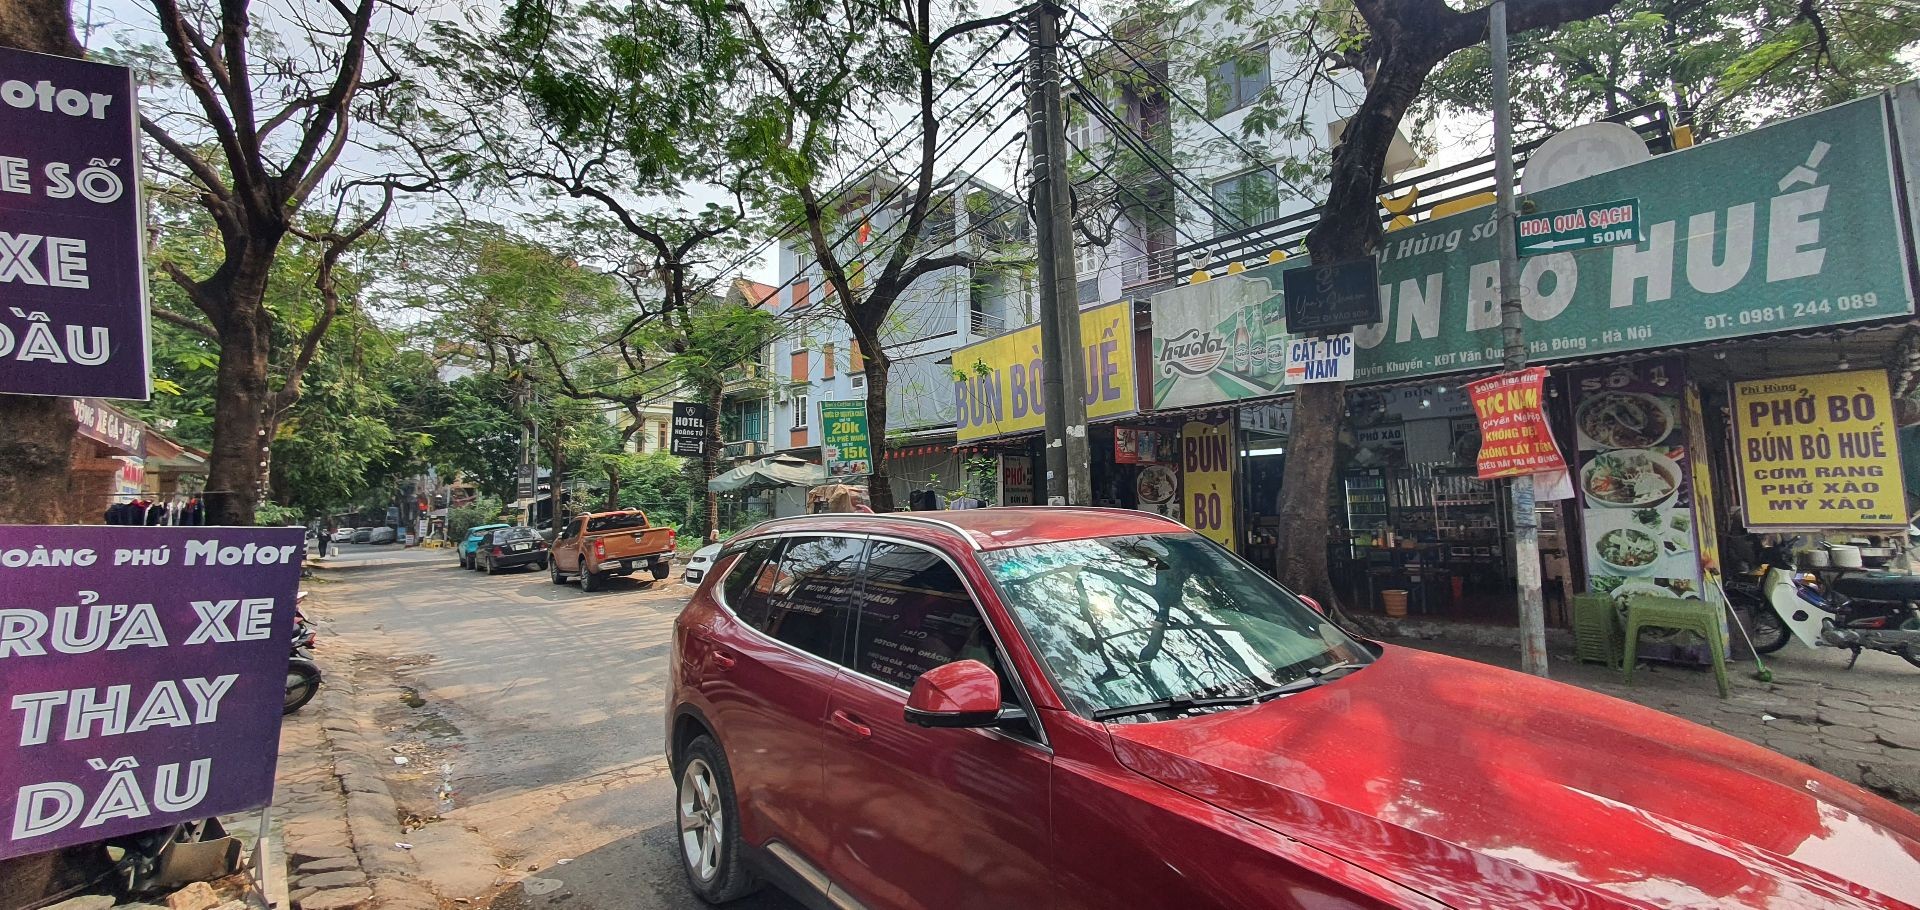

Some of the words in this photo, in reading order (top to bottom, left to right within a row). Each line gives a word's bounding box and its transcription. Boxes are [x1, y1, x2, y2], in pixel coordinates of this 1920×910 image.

[0, 80, 113, 120] otor
[0, 156, 32, 195] E
[45, 157, 124, 204] SỐ
[1520, 218, 1551, 237] HOA
[1554, 208, 1586, 233] QUẢ
[1589, 205, 1632, 229] SẠCH
[1592, 228, 1632, 243] 50M
[1610, 140, 1831, 308] HUẾ
[0, 231, 90, 290] XE
[1396, 228, 1463, 260] Hùng
[1704, 314, 1733, 330] ĐT:
[1739, 307, 1785, 326] 0981
[1793, 300, 1832, 319] 244
[1838, 292, 1877, 312] 089
[1160, 328, 1227, 362] huda
[1325, 333, 1351, 358] TÓC
[1355, 361, 1383, 378] guyễn
[1435, 352, 1456, 367] KĐT
[1459, 349, 1482, 363] Văn
[1530, 341, 1548, 353] Hà
[1552, 337, 1587, 351] Đông
[1602, 330, 1622, 344] Hà
[1627, 325, 1652, 342] Nội
[1082, 318, 1121, 407] UẾ
[1304, 358, 1338, 380] NAM
[1507, 388, 1538, 411] NAM
[1741, 385, 1760, 396] Phi
[1763, 383, 1797, 394] Hùng
[675, 416, 704, 428] HOTEL
[1749, 388, 1816, 427] PHỞ
[1827, 386, 1876, 422] BÒ
[832, 422, 859, 435] 20k
[1485, 427, 1519, 442] KHÔNG
[1747, 431, 1794, 463] BÚN
[1800, 427, 1831, 460] BÒ
[1838, 422, 1887, 458] HUẾ
[842, 446, 867, 459] 15k
[1185, 427, 1228, 473] BÚN
[1754, 467, 1807, 480] CƠM
[1815, 466, 1884, 478] RANG
[1761, 480, 1814, 495] PHỞ
[1823, 480, 1880, 494] XÀO
[1194, 483, 1222, 531] BÒ
[1819, 497, 1875, 510] XÀO
[0, 545, 98, 568] OÀNG
[113, 545, 171, 566] PHÚ
[184, 540, 296, 566] Motor
[0, 590, 169, 659] RỬA
[184, 597, 275, 646] XE
[11, 673, 240, 747] THAY
[11, 755, 213, 841] DẦU
